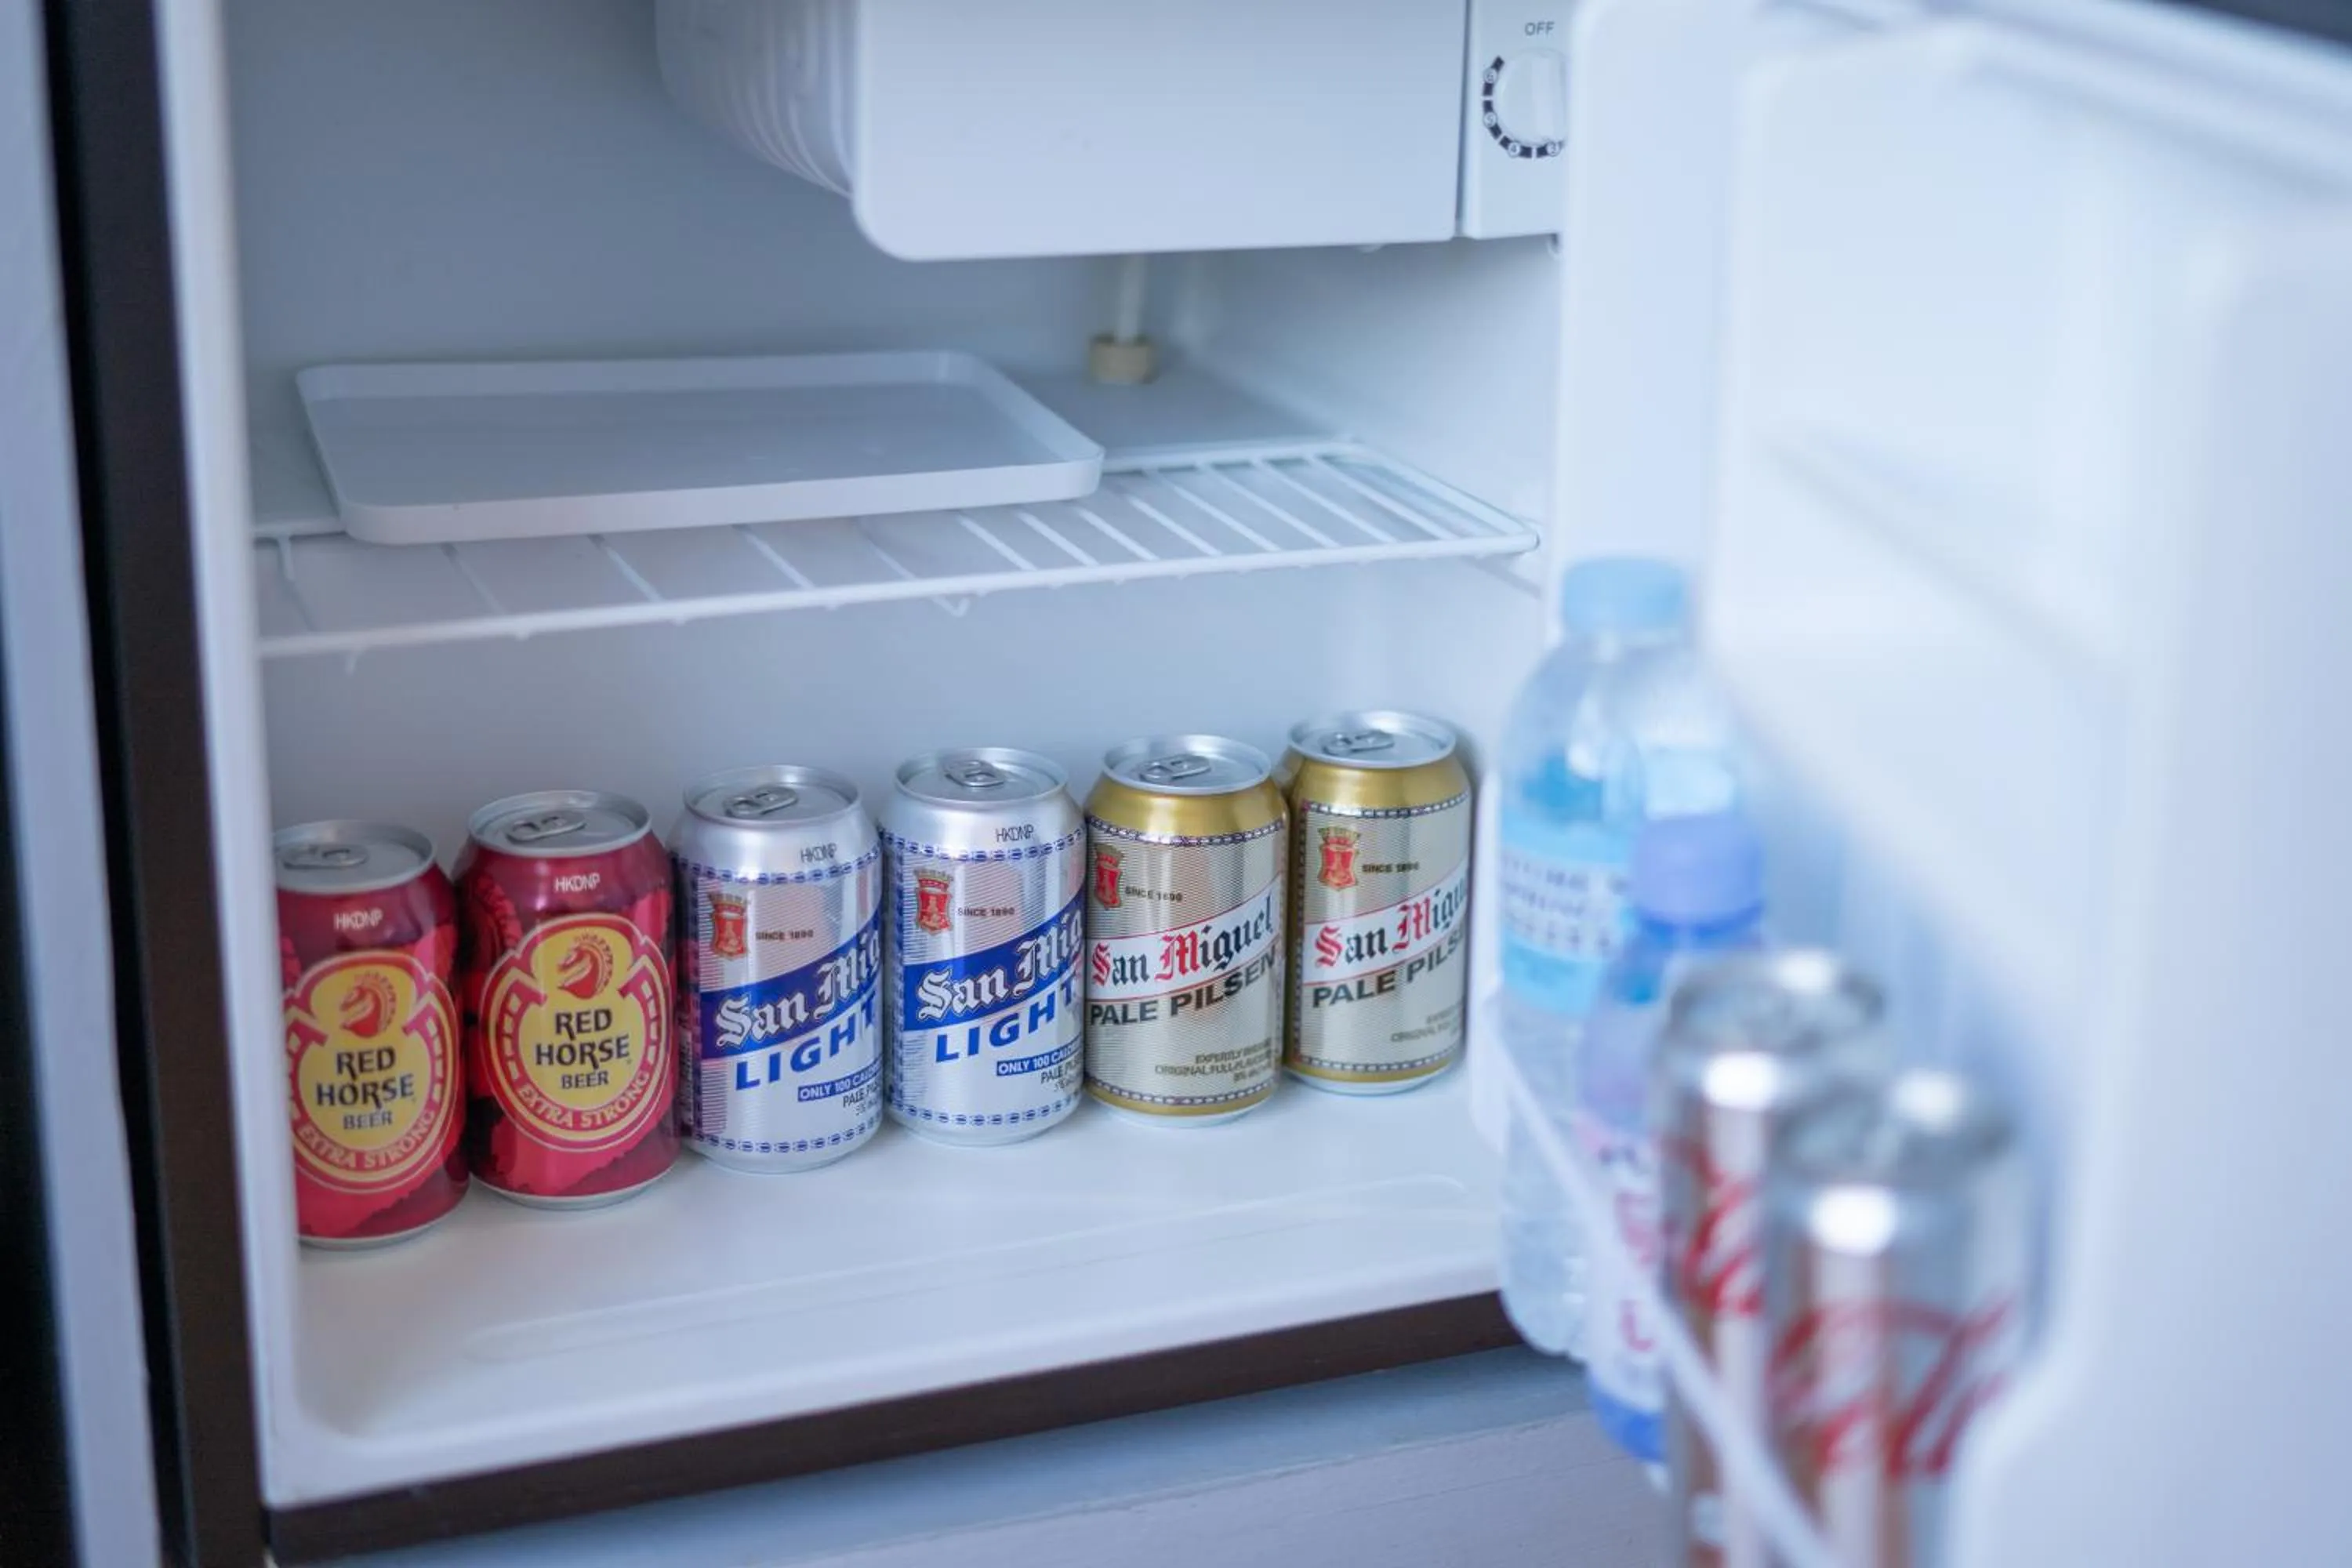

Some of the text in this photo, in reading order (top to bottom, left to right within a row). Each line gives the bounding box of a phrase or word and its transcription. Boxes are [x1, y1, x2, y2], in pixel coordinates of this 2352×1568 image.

[1524, 21, 1555, 36] OFF
[995, 823, 1034, 843] HKDNP
[554, 872, 601, 893] HKDNP
[1362, 863, 1392, 873] SINCE
[1125, 885, 1153, 899] SINCE
[333, 908, 383, 932] HKDNP
[957, 907, 986, 916] SINCE
[1091, 892, 1274, 987] San Miguel
[1315, 924, 1388, 969] San
[915, 964, 1008, 1022] San
[1091, 945, 1276, 1026] PALE PILSEN
[1312, 971, 1396, 1008] PALE
[554, 1007, 613, 1041] RED
[715, 989, 810, 1048] San
[935, 970, 1077, 1063] LIGHT
[535, 1034, 631, 1071] HORSE
[735, 990, 877, 1091] LIGHT
[336, 1046, 397, 1081] RED
[561, 1069, 609, 1090] BEER
[998, 1061, 1030, 1075] ONLY
[1033, 1054, 1050, 1069] 100
[316, 1073, 416, 1112] HORSE
[517, 1070, 650, 1129] EXTRA STRONG
[800, 1084, 832, 1100] ONLY
[835, 1078, 851, 1093] 100
[342, 1110, 394, 1131] BEER
[296, 1109, 436, 1168] EXTRA STRONG
